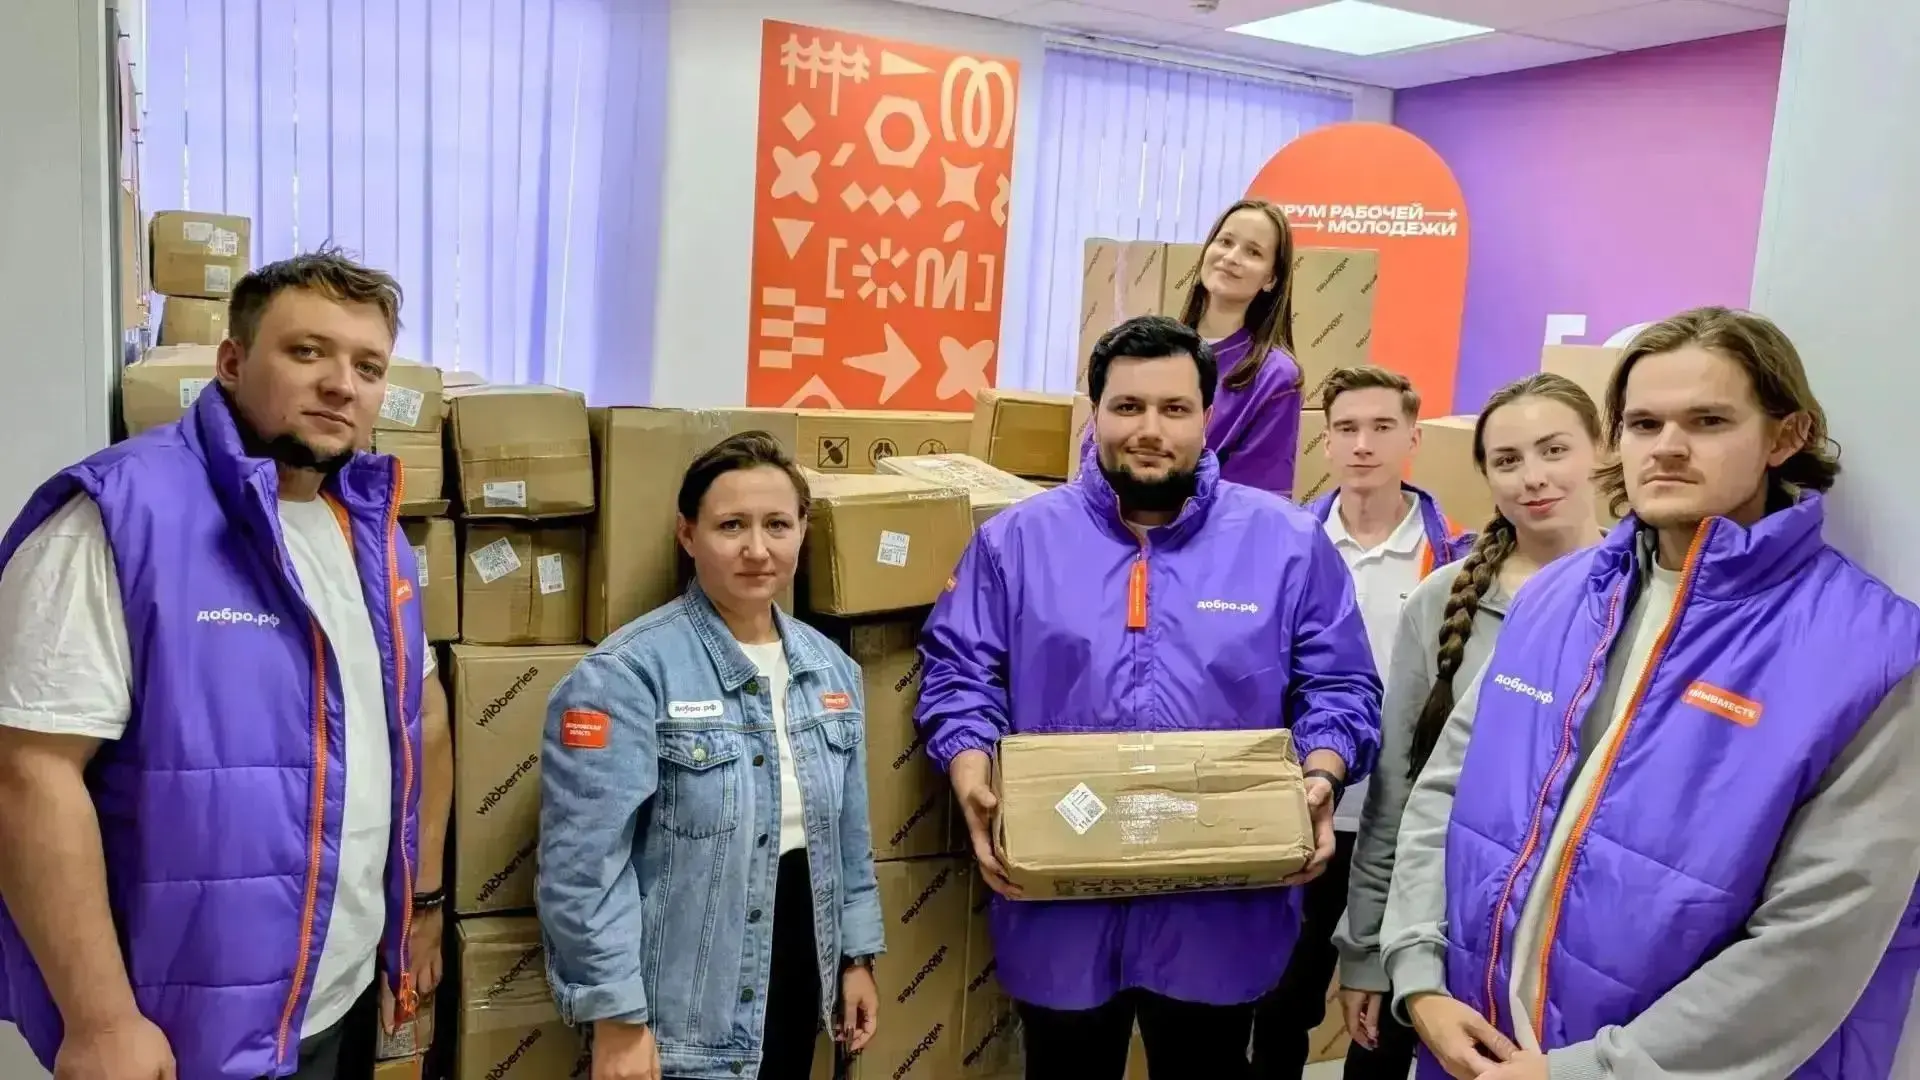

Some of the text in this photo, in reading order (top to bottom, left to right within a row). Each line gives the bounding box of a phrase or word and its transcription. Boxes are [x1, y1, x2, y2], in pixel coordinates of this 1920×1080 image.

[1276, 202, 1424, 220] РУМ РАБОЧЕЙ
[1327, 219, 1457, 237] МОЛОДЕЖИ
[196, 607, 281, 628] добро.рф
[1196, 599, 1259, 614] добро.рф
[476, 666, 539, 728] wildberries
[1494, 673, 1555, 705] добро.рф
[476, 753, 539, 816] wildberries
[898, 945, 948, 1004] wildberries
[484, 1028, 542, 1080] ildberries
